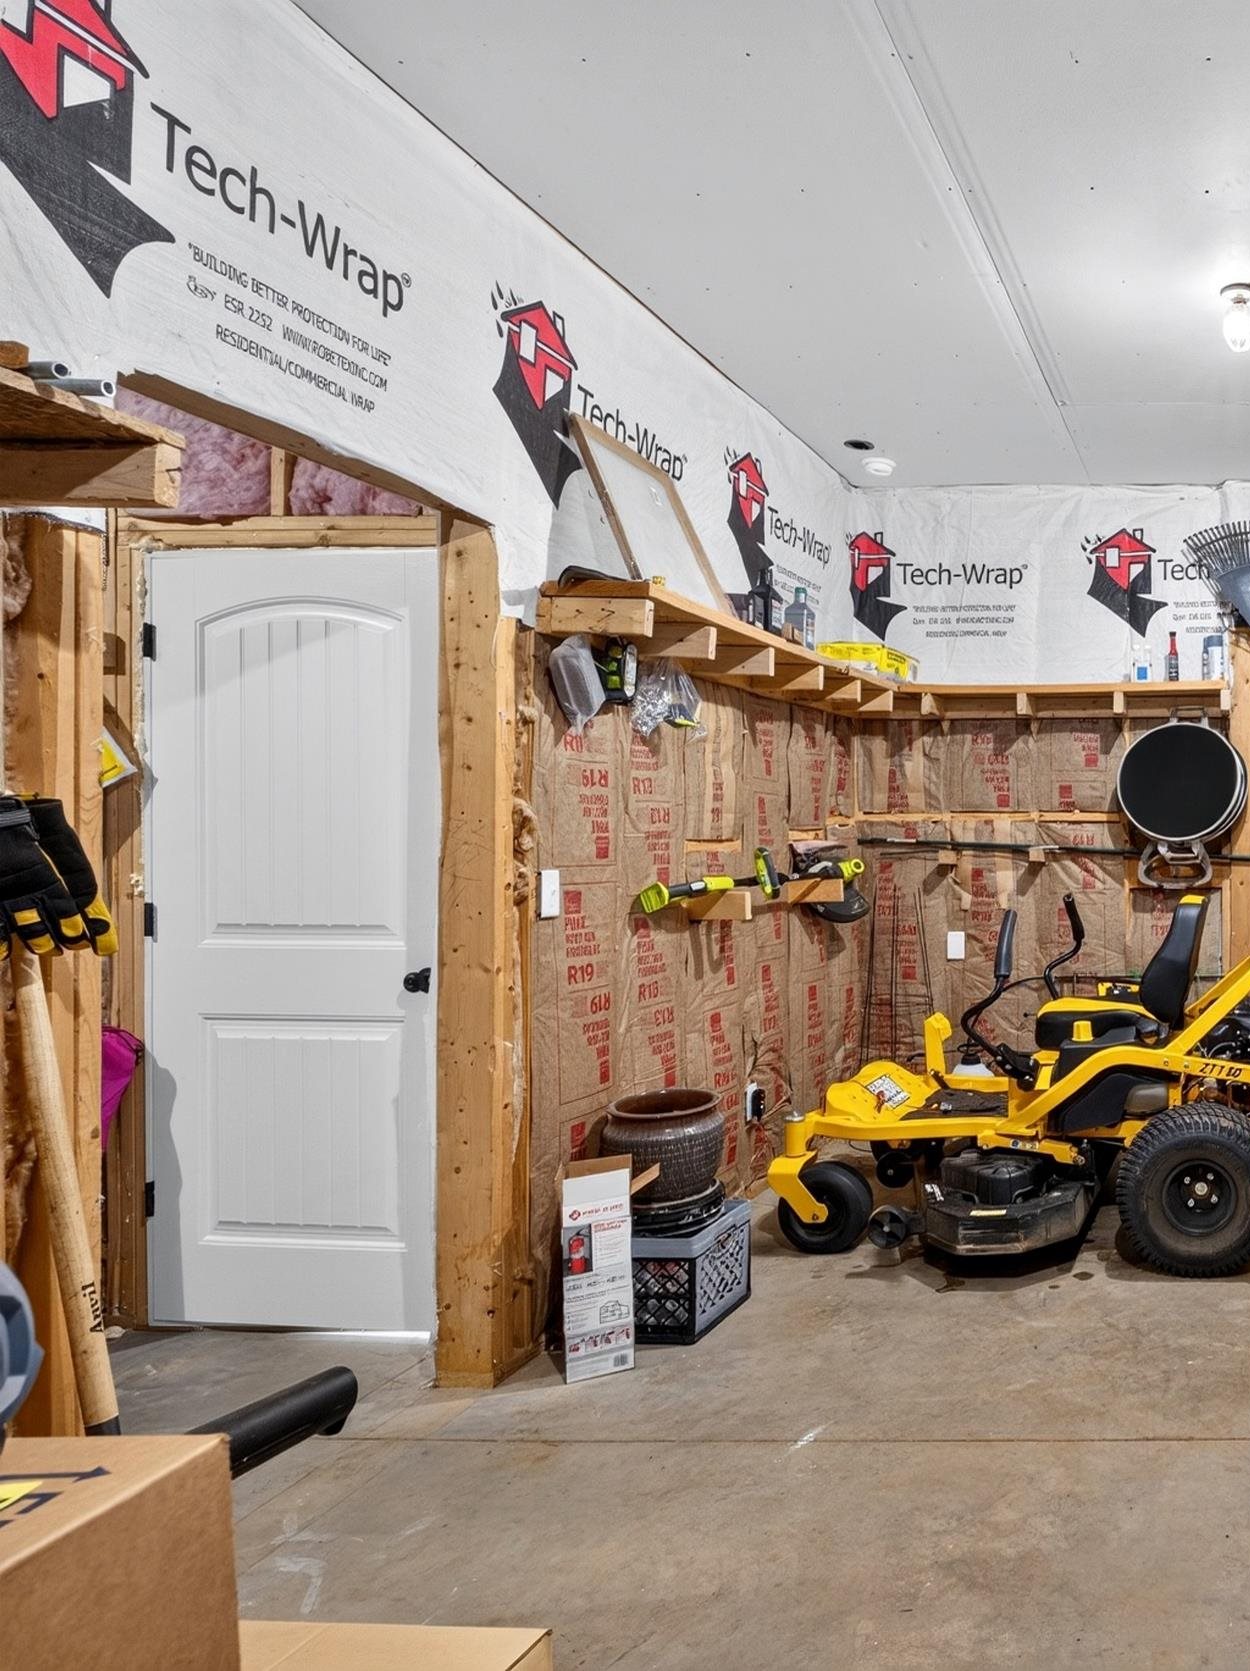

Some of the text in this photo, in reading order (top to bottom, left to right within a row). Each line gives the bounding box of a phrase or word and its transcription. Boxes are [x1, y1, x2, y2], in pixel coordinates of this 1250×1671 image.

[291, 300, 350, 345] PROTECTION
[352, 335, 369, 354] FOR
[567, 962, 595, 985] R19
[590, 991, 611, 1015] R19
